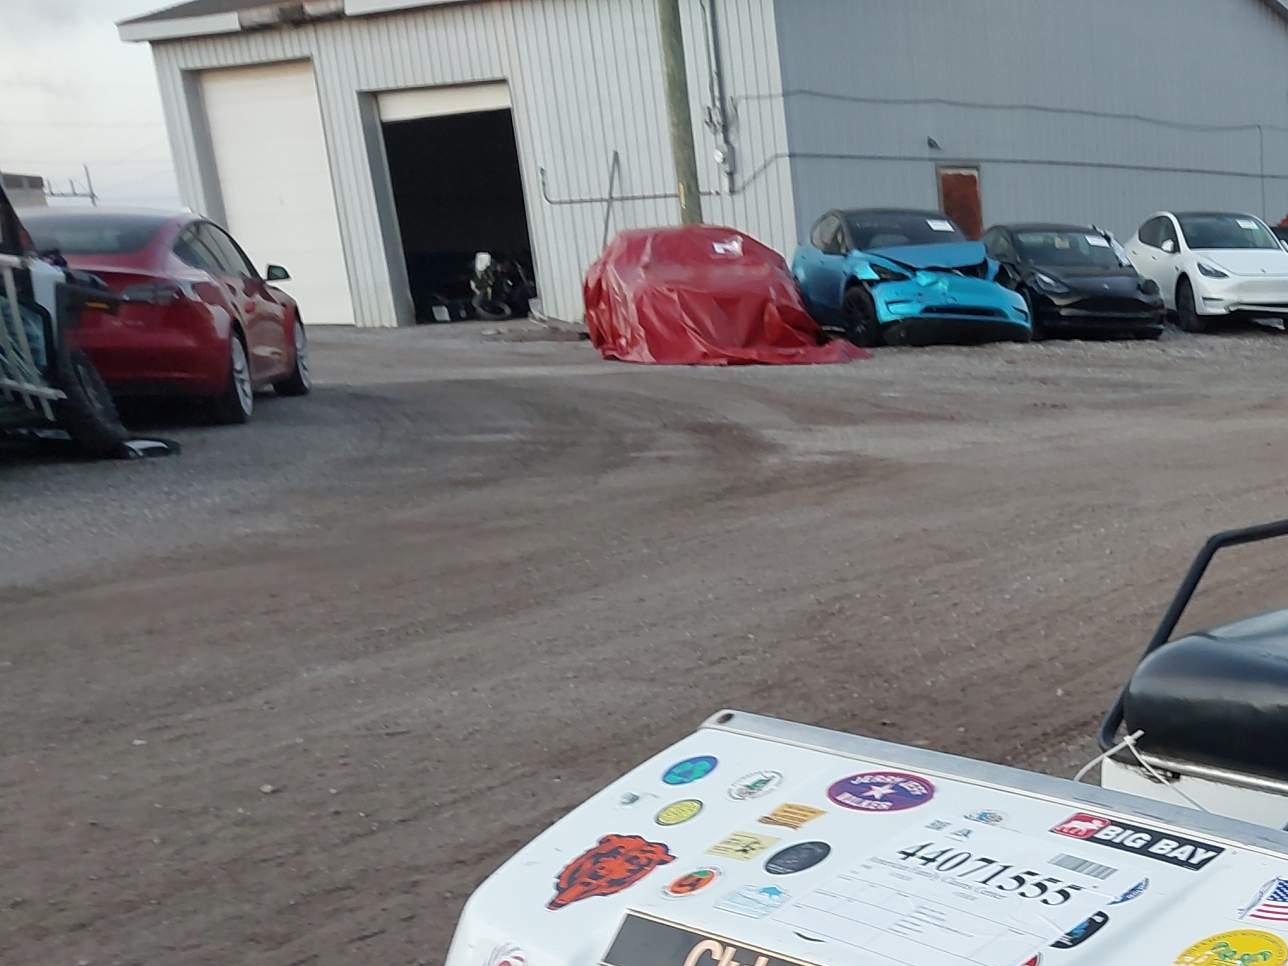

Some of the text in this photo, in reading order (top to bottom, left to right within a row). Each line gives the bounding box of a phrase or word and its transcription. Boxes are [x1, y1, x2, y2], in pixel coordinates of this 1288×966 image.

[1095, 824, 1218, 864] BIG BAY
[897, 842, 1086, 905] 44071555
